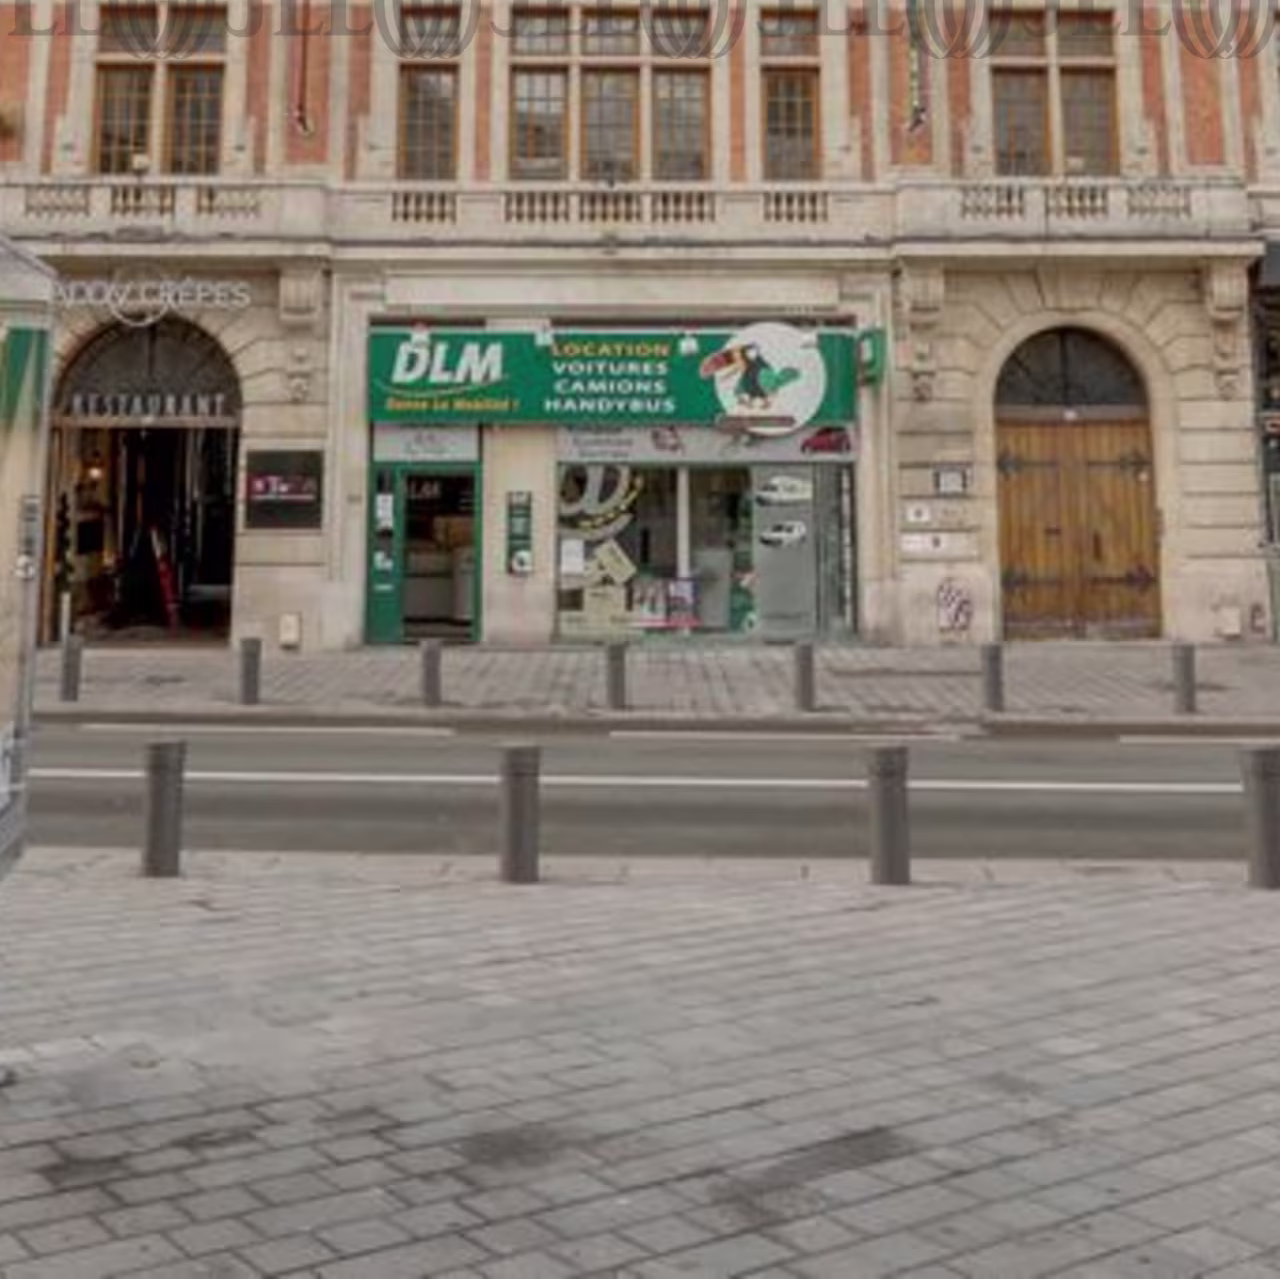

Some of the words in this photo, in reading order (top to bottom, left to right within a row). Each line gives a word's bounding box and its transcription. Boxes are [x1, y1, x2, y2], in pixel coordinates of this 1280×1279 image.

[551, 342, 670, 358] LOCATION
[391, 341, 503, 384] DLM
[552, 360, 669, 376] VOITURES
[553, 378, 667, 395] CAMIONS
[72, 392, 226, 417] RESTAURANT
[544, 397, 676, 414] HANDYBUS
